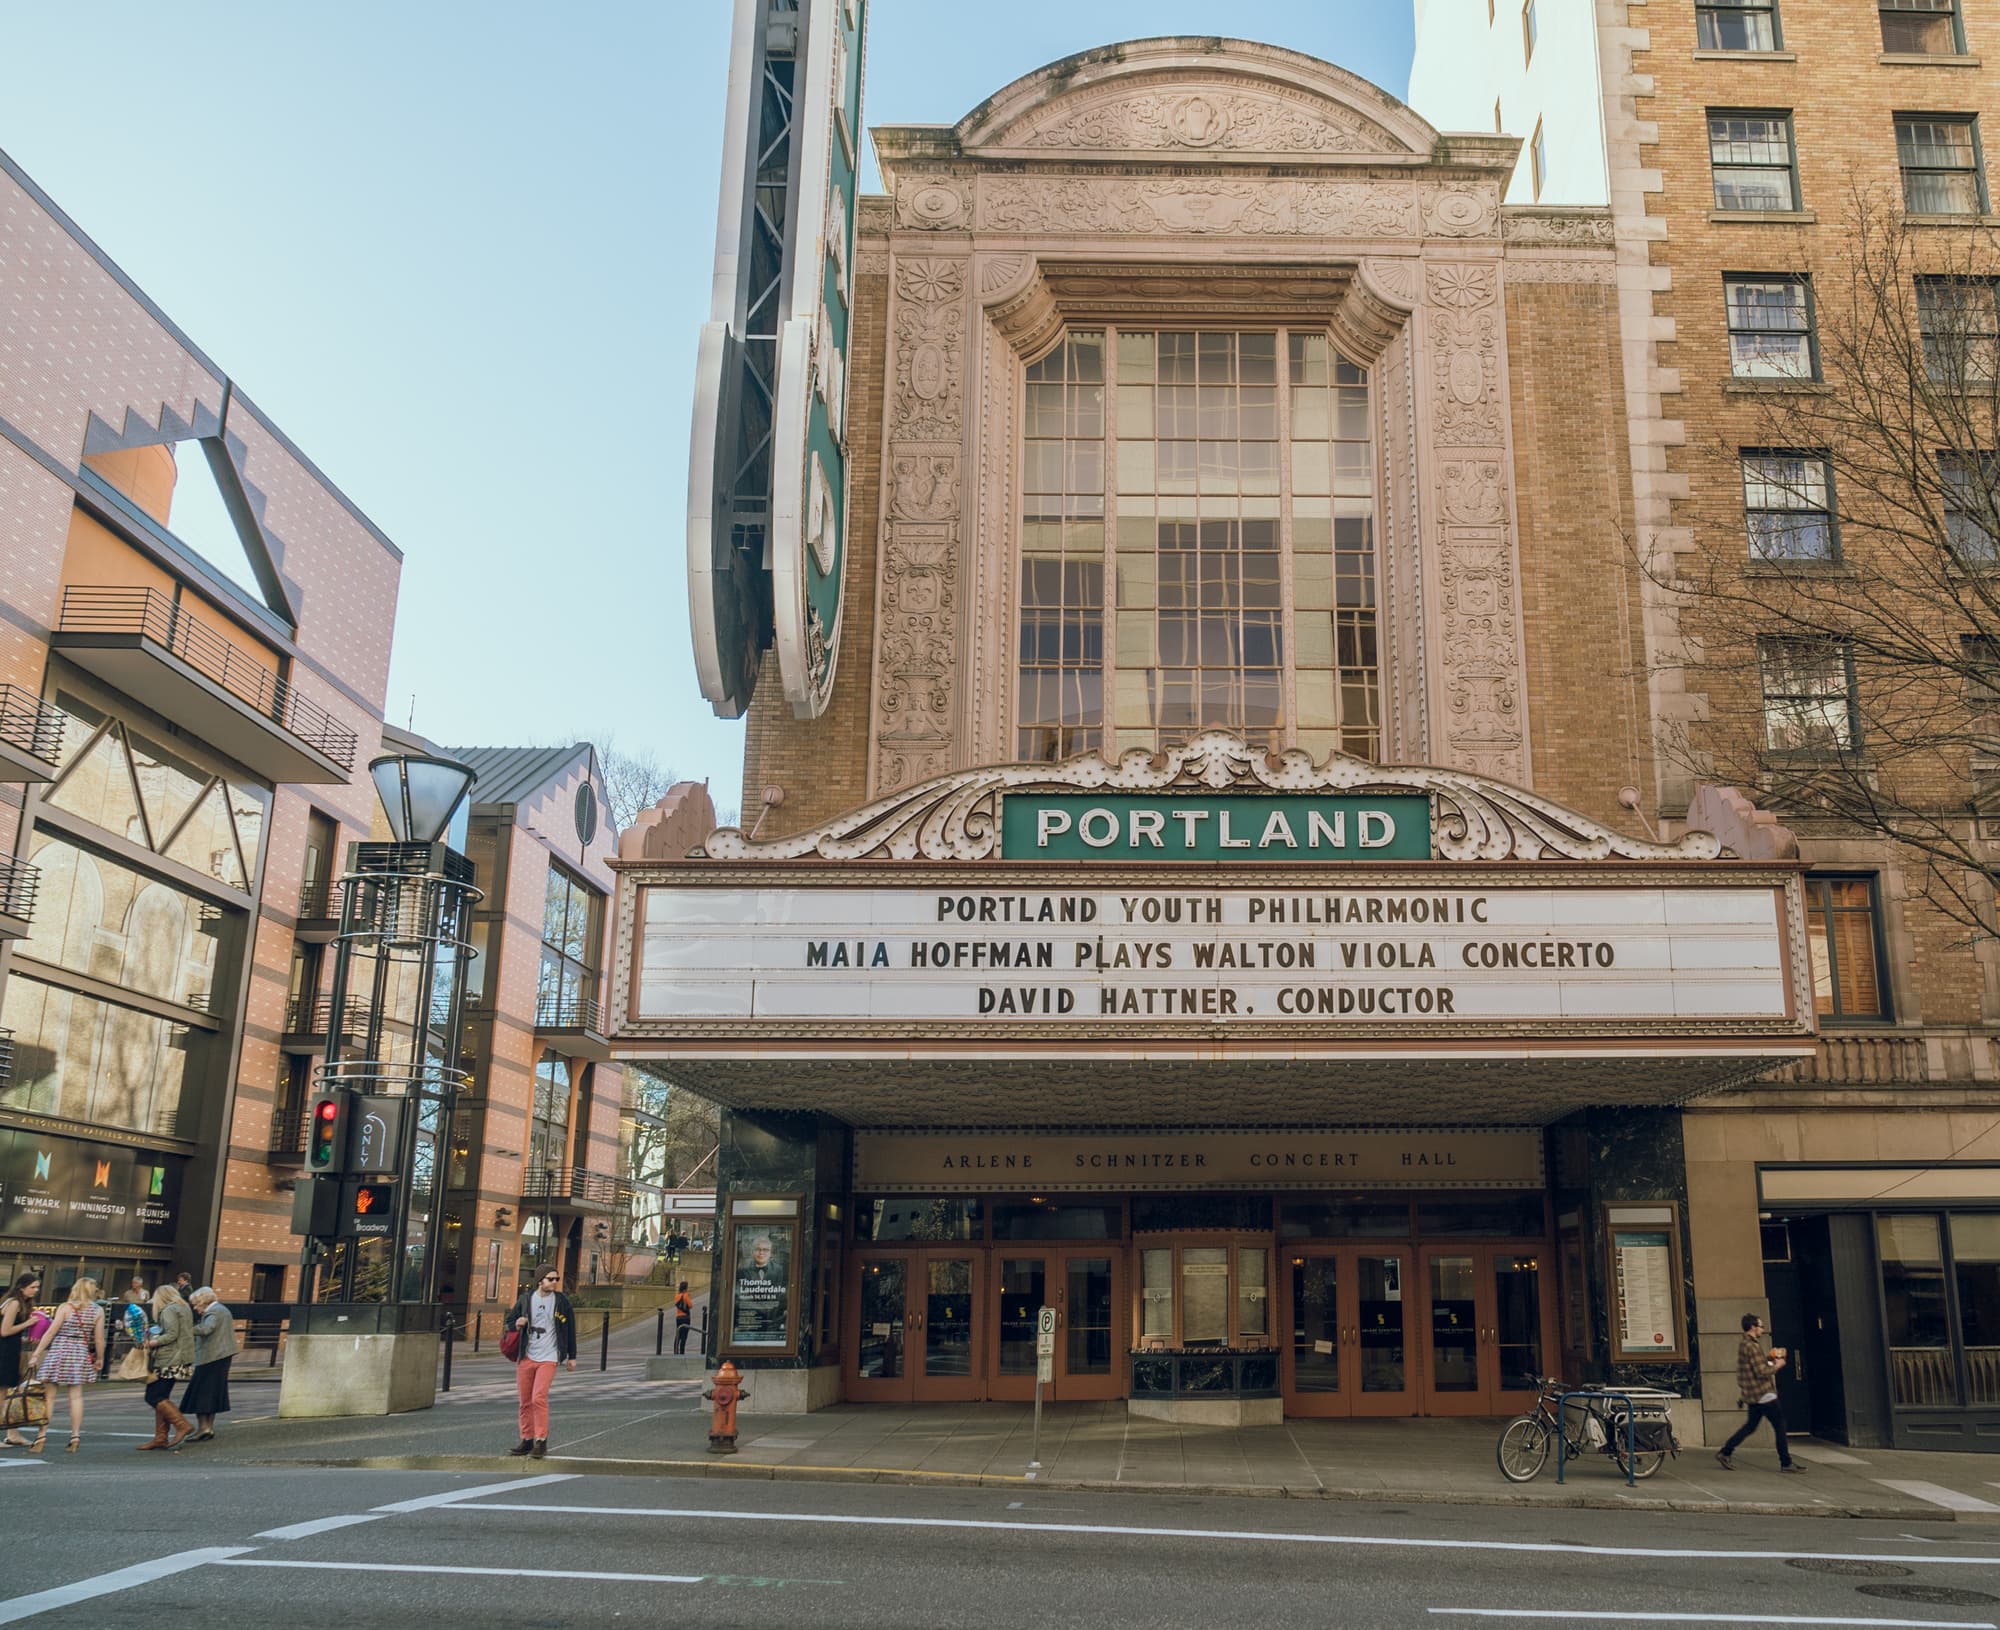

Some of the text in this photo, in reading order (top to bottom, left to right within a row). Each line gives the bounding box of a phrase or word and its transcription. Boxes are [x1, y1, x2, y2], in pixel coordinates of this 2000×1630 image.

[1036, 808, 1396, 848] PORTLAND
[937, 896, 1488, 923] PORTLAND YOUTH PHILHARMONIC
[806, 941, 1614, 969] MAIA HOFFMAN PLAYS WALTON VIOLA CONCERTO
[978, 987, 1075, 1014] DAVID
[1277, 987, 1455, 1014] CONDUCTOR
[360, 1123, 373, 1167] ONLY
[943, 1152, 1457, 1169] ARLENE SCHNITZER CONCERT HALL
[14, 1195, 60, 1209] NEWMARK
[70, 1201, 126, 1215] WINNINGSTAD
[136, 1208, 170, 1219] BRUNISH
[356, 1223, 388, 1232] Broadway
[740, 1286, 786, 1294] Lauderdale
